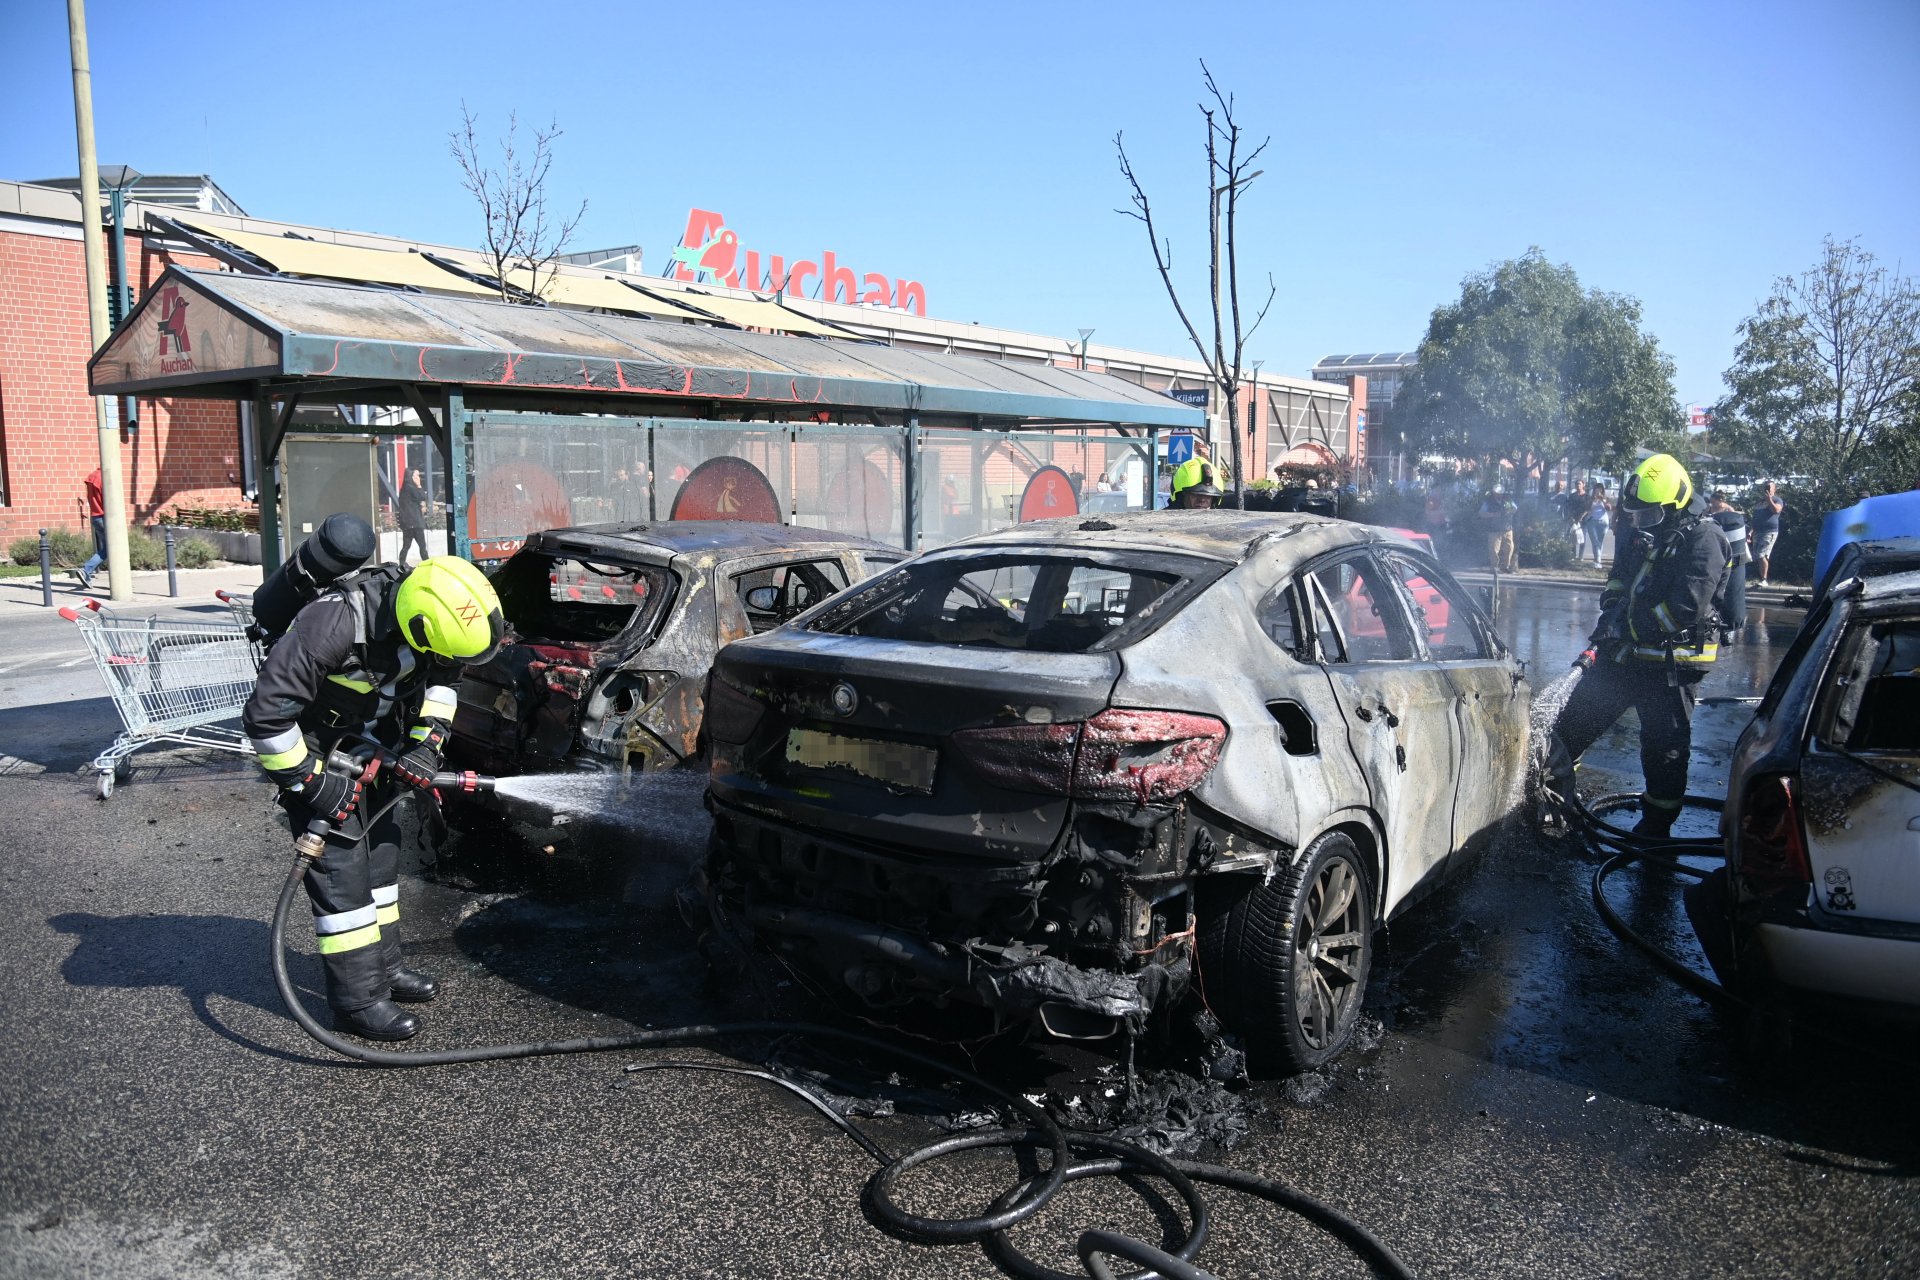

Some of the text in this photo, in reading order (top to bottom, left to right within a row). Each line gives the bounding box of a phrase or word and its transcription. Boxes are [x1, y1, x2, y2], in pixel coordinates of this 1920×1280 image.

[674, 208, 926, 317] Auchan
[161, 358, 193, 373] Auchan
[1176, 394, 1205, 403] Kijárat
